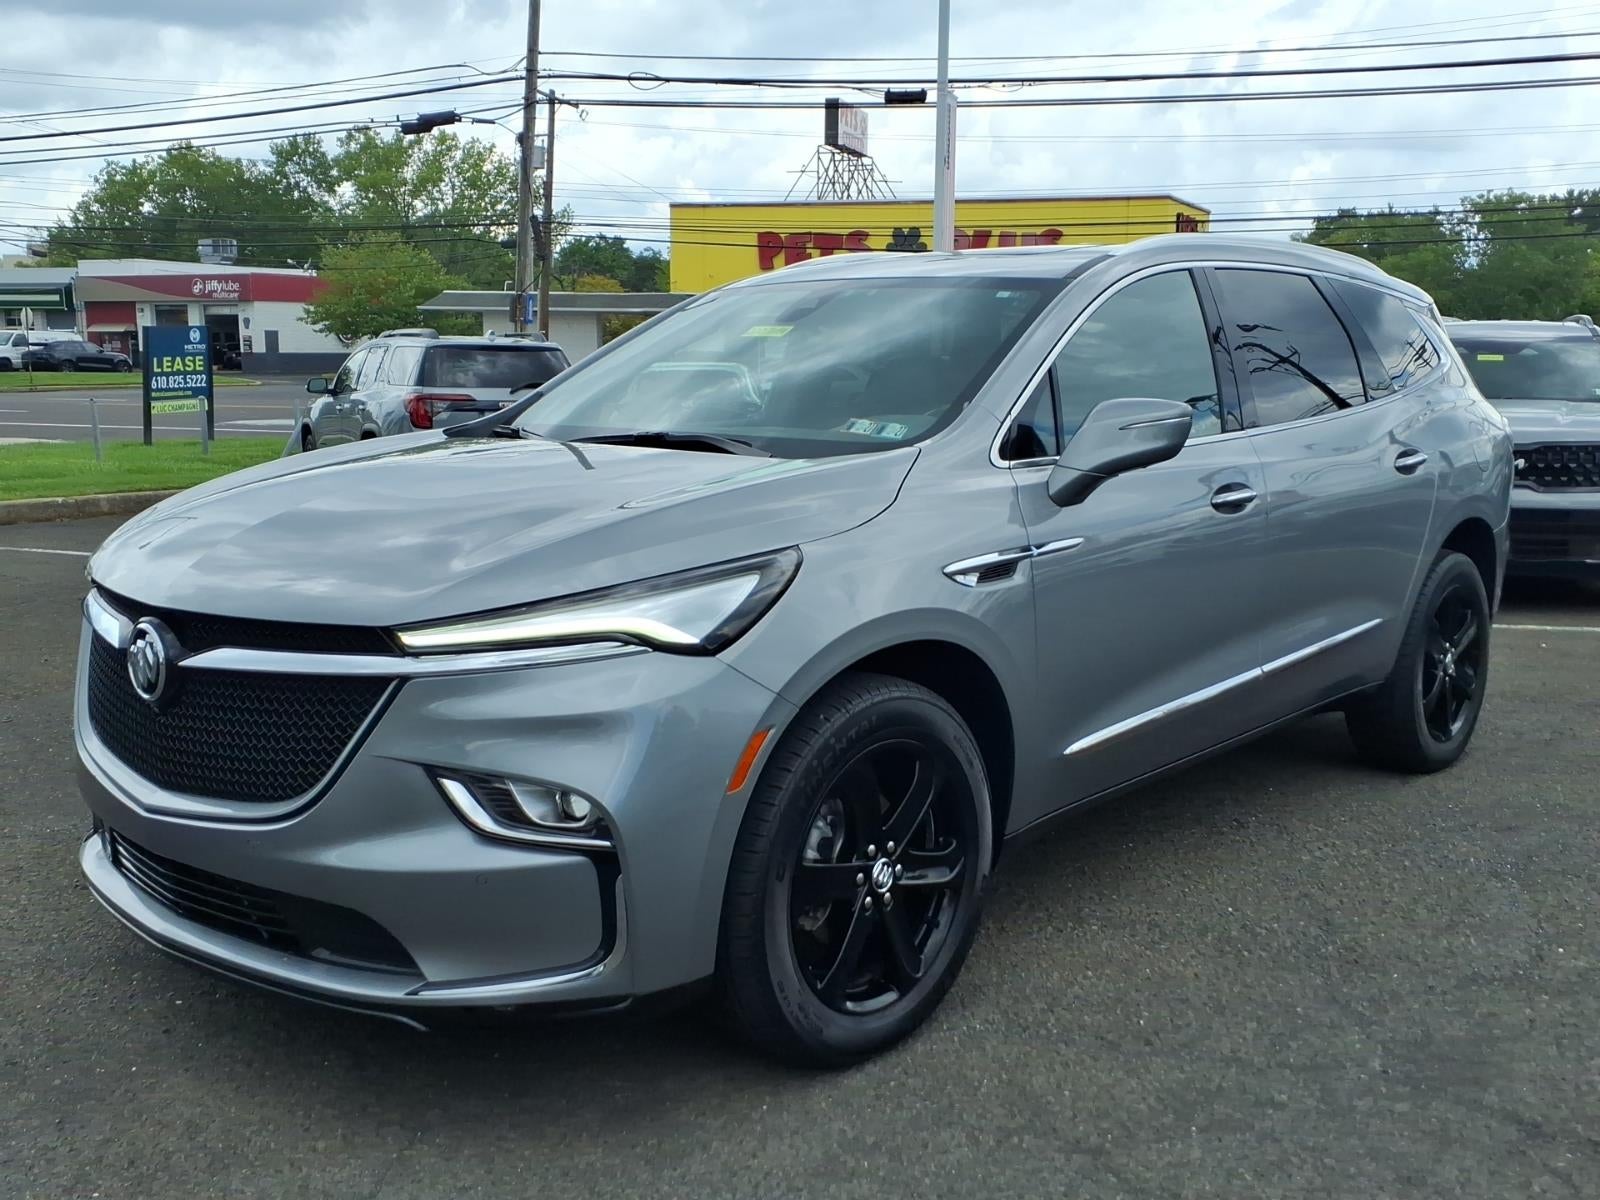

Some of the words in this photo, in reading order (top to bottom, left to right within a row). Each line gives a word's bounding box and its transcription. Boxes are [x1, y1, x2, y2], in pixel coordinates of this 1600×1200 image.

[757, 230, 873, 270] PETS
[153, 356, 204, 373] LEASE
[151, 374, 207, 389] 610.825.5222
